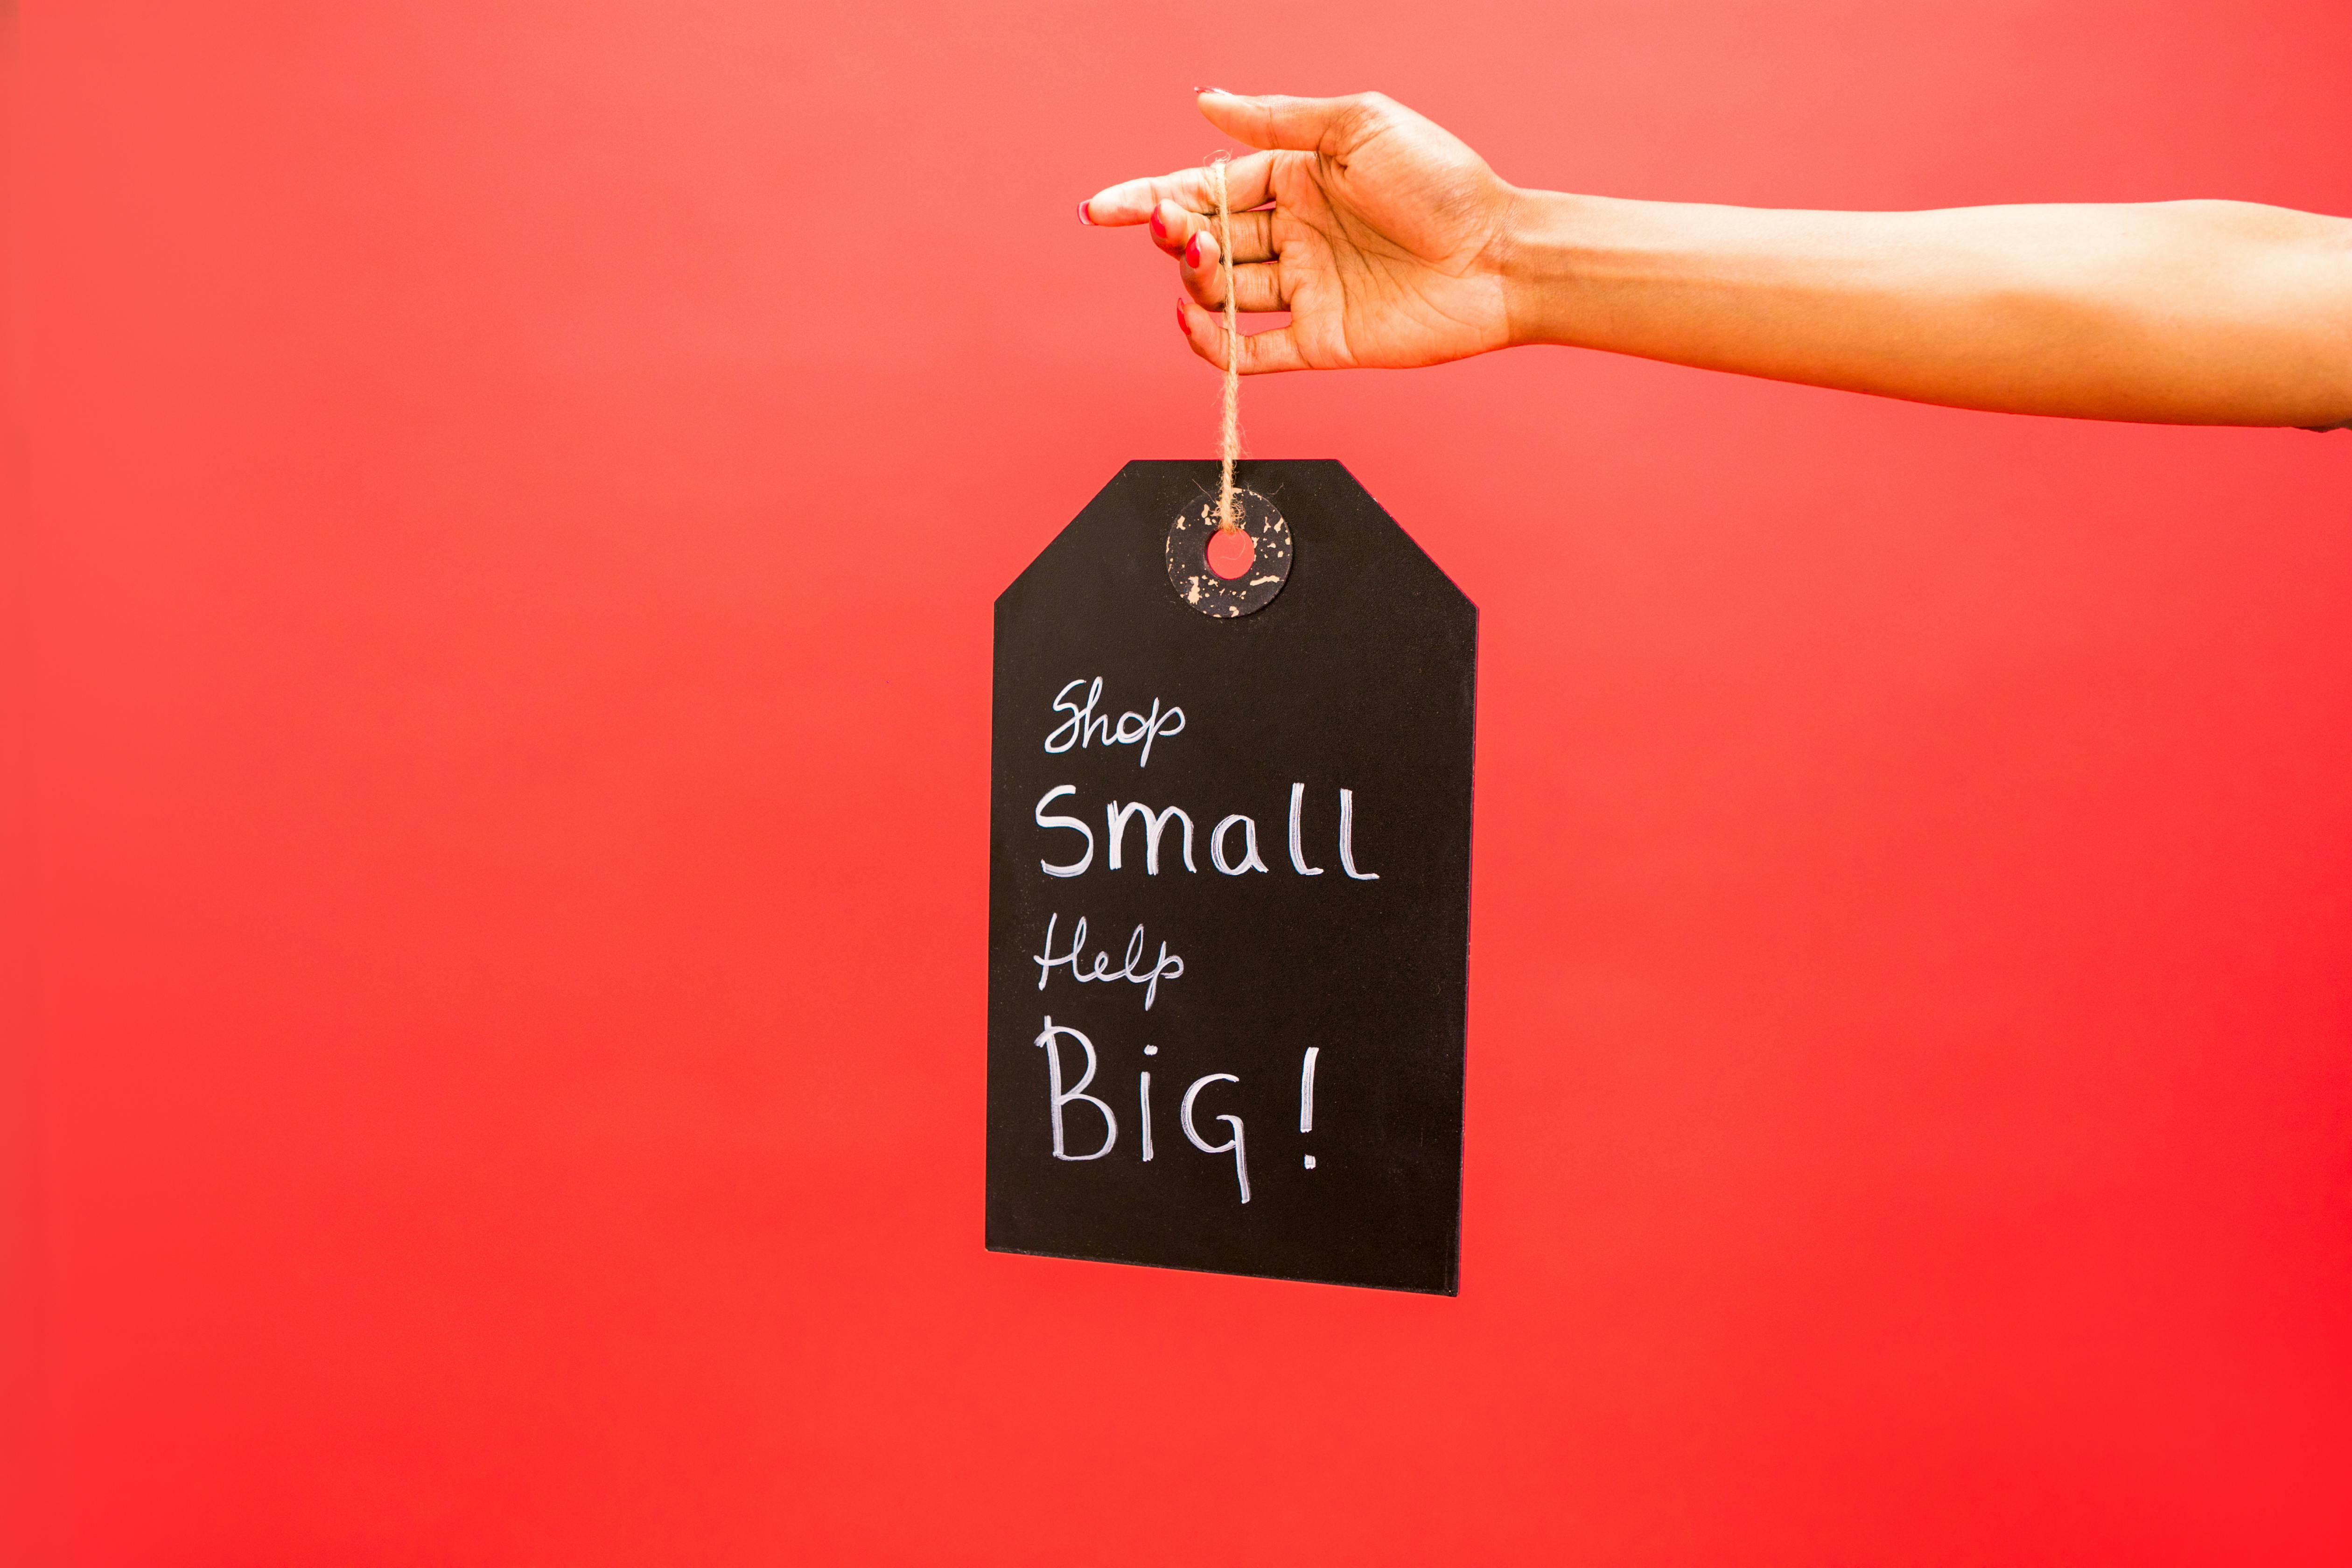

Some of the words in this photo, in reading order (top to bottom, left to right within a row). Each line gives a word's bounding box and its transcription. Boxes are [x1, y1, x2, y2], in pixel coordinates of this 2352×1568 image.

[1045, 676, 1186, 768] Shop
[1035, 782, 1380, 880] Small
[1034, 912, 1184, 1011] Help
